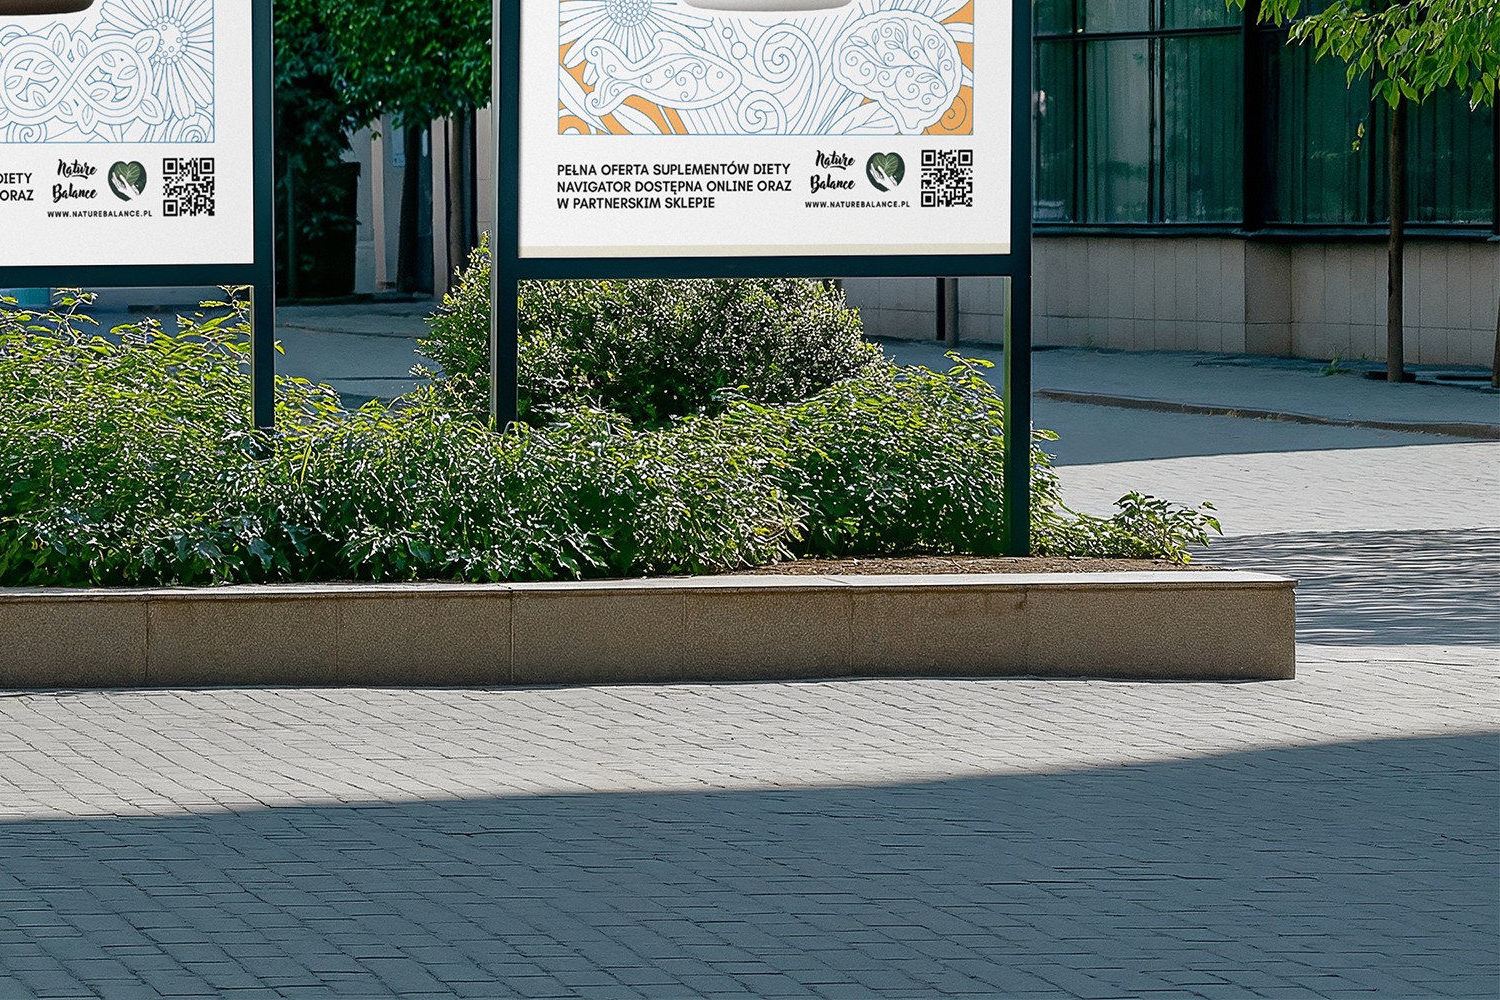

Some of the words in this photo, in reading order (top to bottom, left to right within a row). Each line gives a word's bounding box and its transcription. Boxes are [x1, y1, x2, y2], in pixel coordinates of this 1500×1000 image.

[815, 150, 856, 170] Nature
[57, 158, 97, 179] Nature
[558, 165, 597, 175] PEŁNA
[601, 164, 649, 175] OFERTA
[653, 161, 749, 175] SUPLEMENTÓW
[754, 164, 790, 174] DIETY
[558, 181, 631, 192] NAVIGATOR
[635, 181, 702, 195] DOSTĘPNA
[707, 181, 753, 192] ONLINE
[757, 180, 791, 191] ORAZ
[810, 173, 856, 194] Balance
[0, 190, 34, 201] ORAZ
[52, 183, 98, 203] Balance
[557, 198, 569, 209] W
[574, 198, 661, 209] PARTNERSKIM
[665, 197, 714, 208] SKLEPIE
[805, 200, 910, 208] WWW.NATUREBALANCE.PL
[47, 210, 152, 218] WWW.NATUREBALANCE.PL
